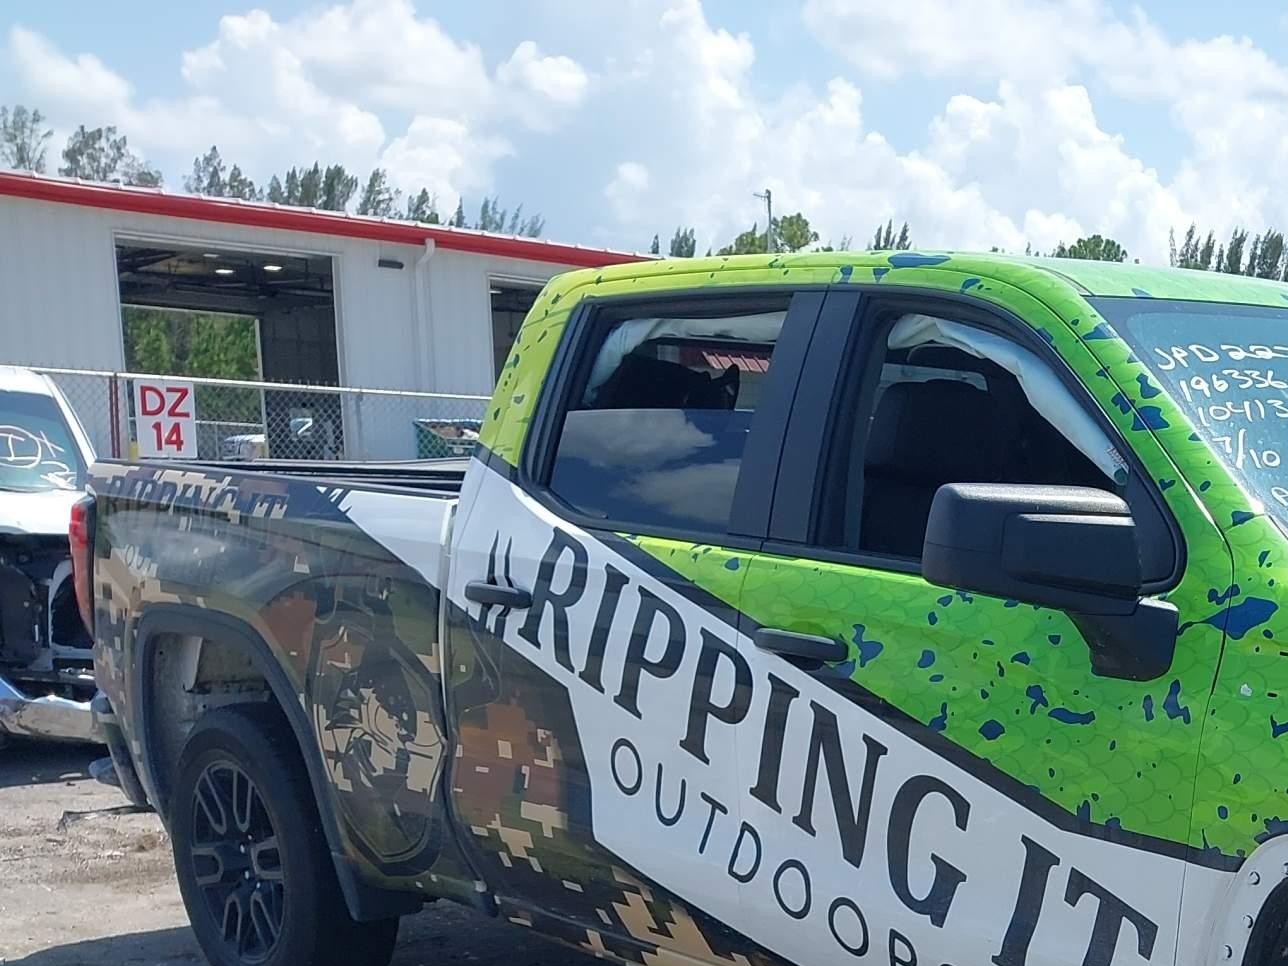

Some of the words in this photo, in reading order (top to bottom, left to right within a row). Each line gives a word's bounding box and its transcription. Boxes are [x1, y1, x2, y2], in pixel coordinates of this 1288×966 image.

[139, 385, 191, 418] DZ
[1179, 369, 1288, 402] 196336
[151, 421, 184, 452] 14
[1212, 428, 1281, 470] 7/10
[517, 526, 971, 929] RIPPING
